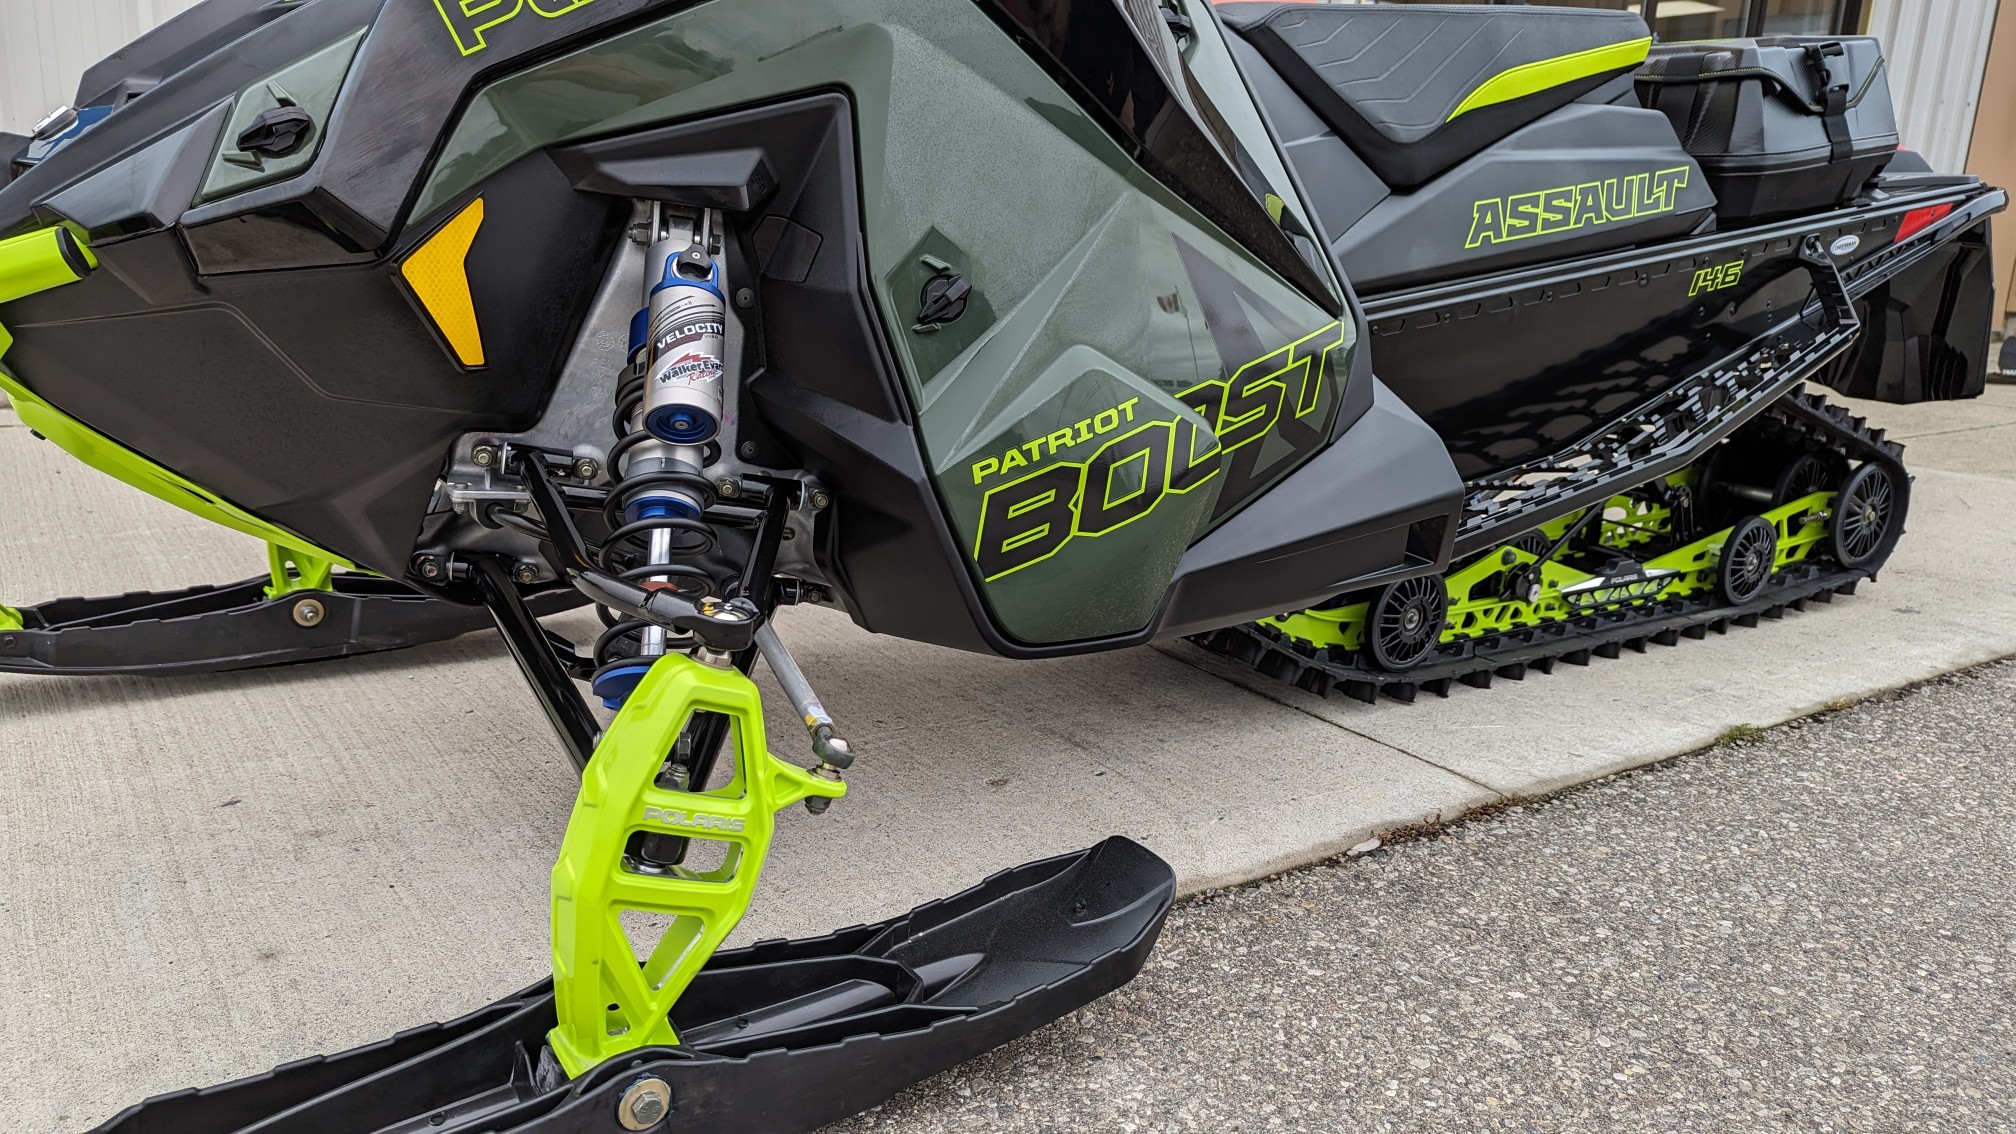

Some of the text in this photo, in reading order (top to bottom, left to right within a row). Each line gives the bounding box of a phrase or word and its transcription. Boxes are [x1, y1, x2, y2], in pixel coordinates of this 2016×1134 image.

[1464, 166, 1690, 249] ASSAULT
[1688, 260, 1745, 297] 146
[656, 322, 723, 350] VELOCITY
[659, 361, 703, 384] Walker
[971, 397, 1140, 485] PATRIOT
[974, 320, 1345, 583] BOOST
[1611, 574, 1638, 584] POLARIS
[643, 805, 746, 832] POLARIS
